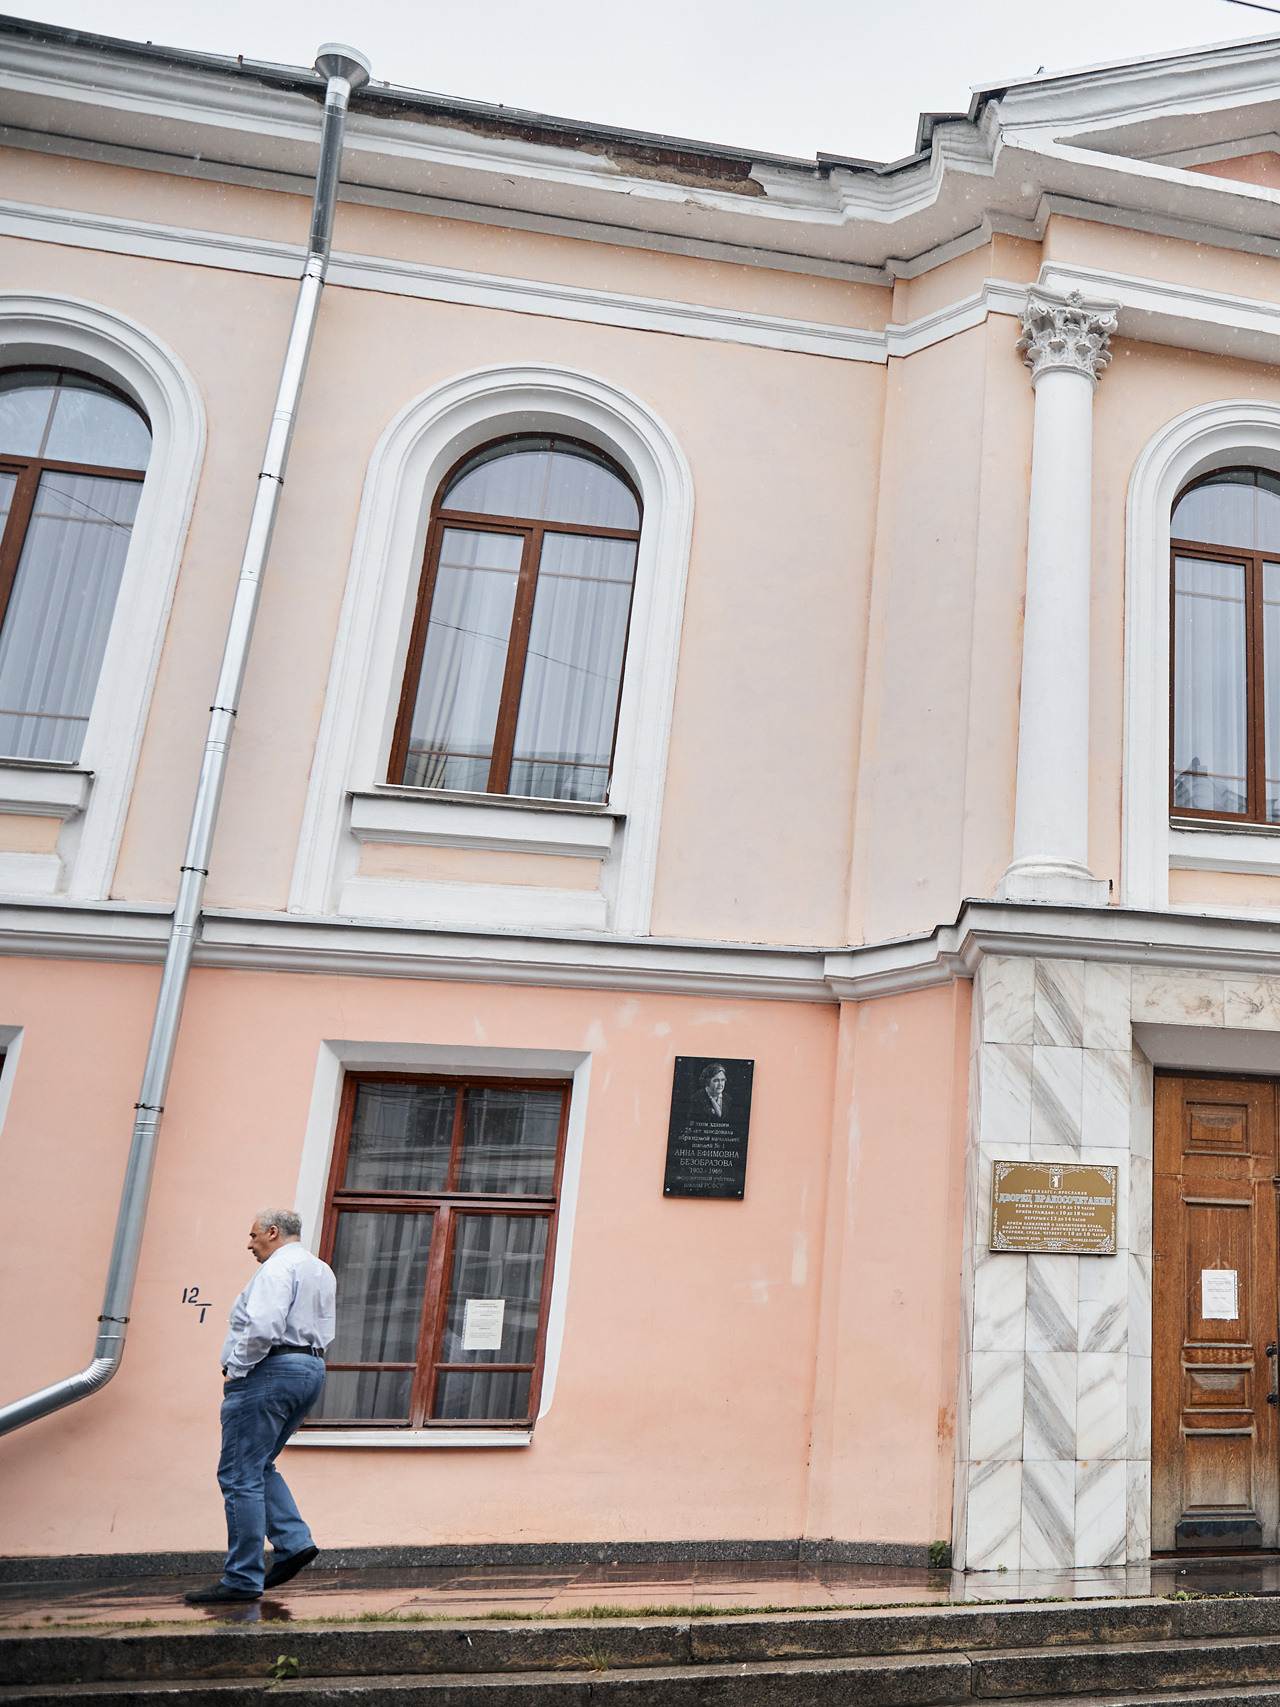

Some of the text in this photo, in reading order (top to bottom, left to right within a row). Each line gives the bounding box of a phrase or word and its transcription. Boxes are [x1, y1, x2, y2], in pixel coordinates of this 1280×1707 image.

[697, 1150, 739, 1158] ЕФИМОВНА
[680, 1158, 733, 1167] БЕЗОБРАЗОВА
[999, 1193, 1112, 1206] ДВОРЕЦ БРАКОСОЧЕТАНИЯ
[182, 1287, 199, 1303] 12
